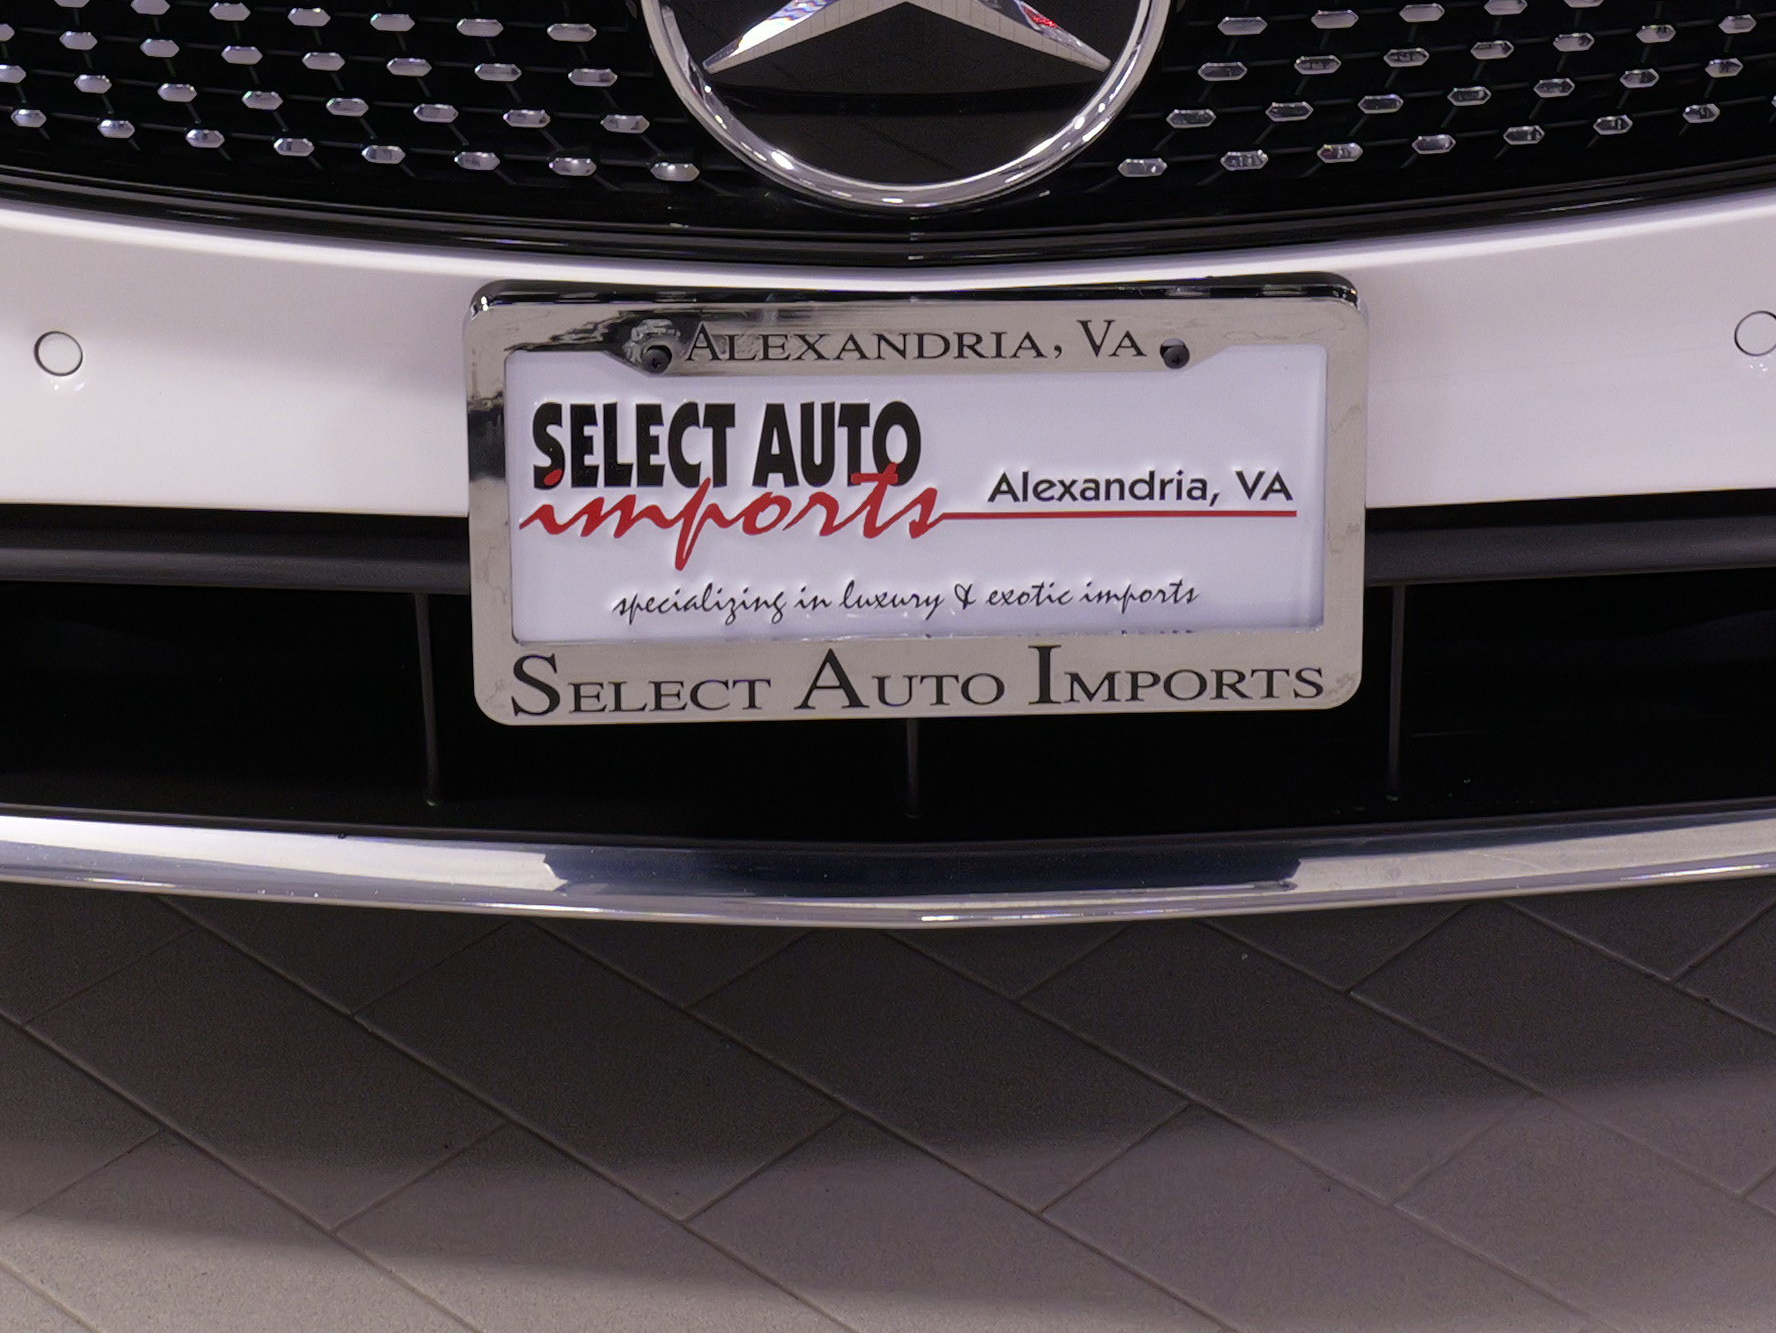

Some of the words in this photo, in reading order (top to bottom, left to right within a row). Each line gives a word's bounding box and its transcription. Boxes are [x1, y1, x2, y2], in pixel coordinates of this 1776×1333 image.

[531, 400, 735, 489] SELECT
[751, 400, 922, 487] AUTO
[519, 461, 941, 571] imports
[987, 470, 1221, 507] Alexandria,
[1235, 470, 1294, 501] VA
[611, 582, 787, 625] specializing
[794, 585, 832, 612] in
[839, 579, 945, 620] luxury
[954, 583, 976, 610] &
[986, 581, 1073, 607] exotic
[1079, 578, 1200, 614] imports
